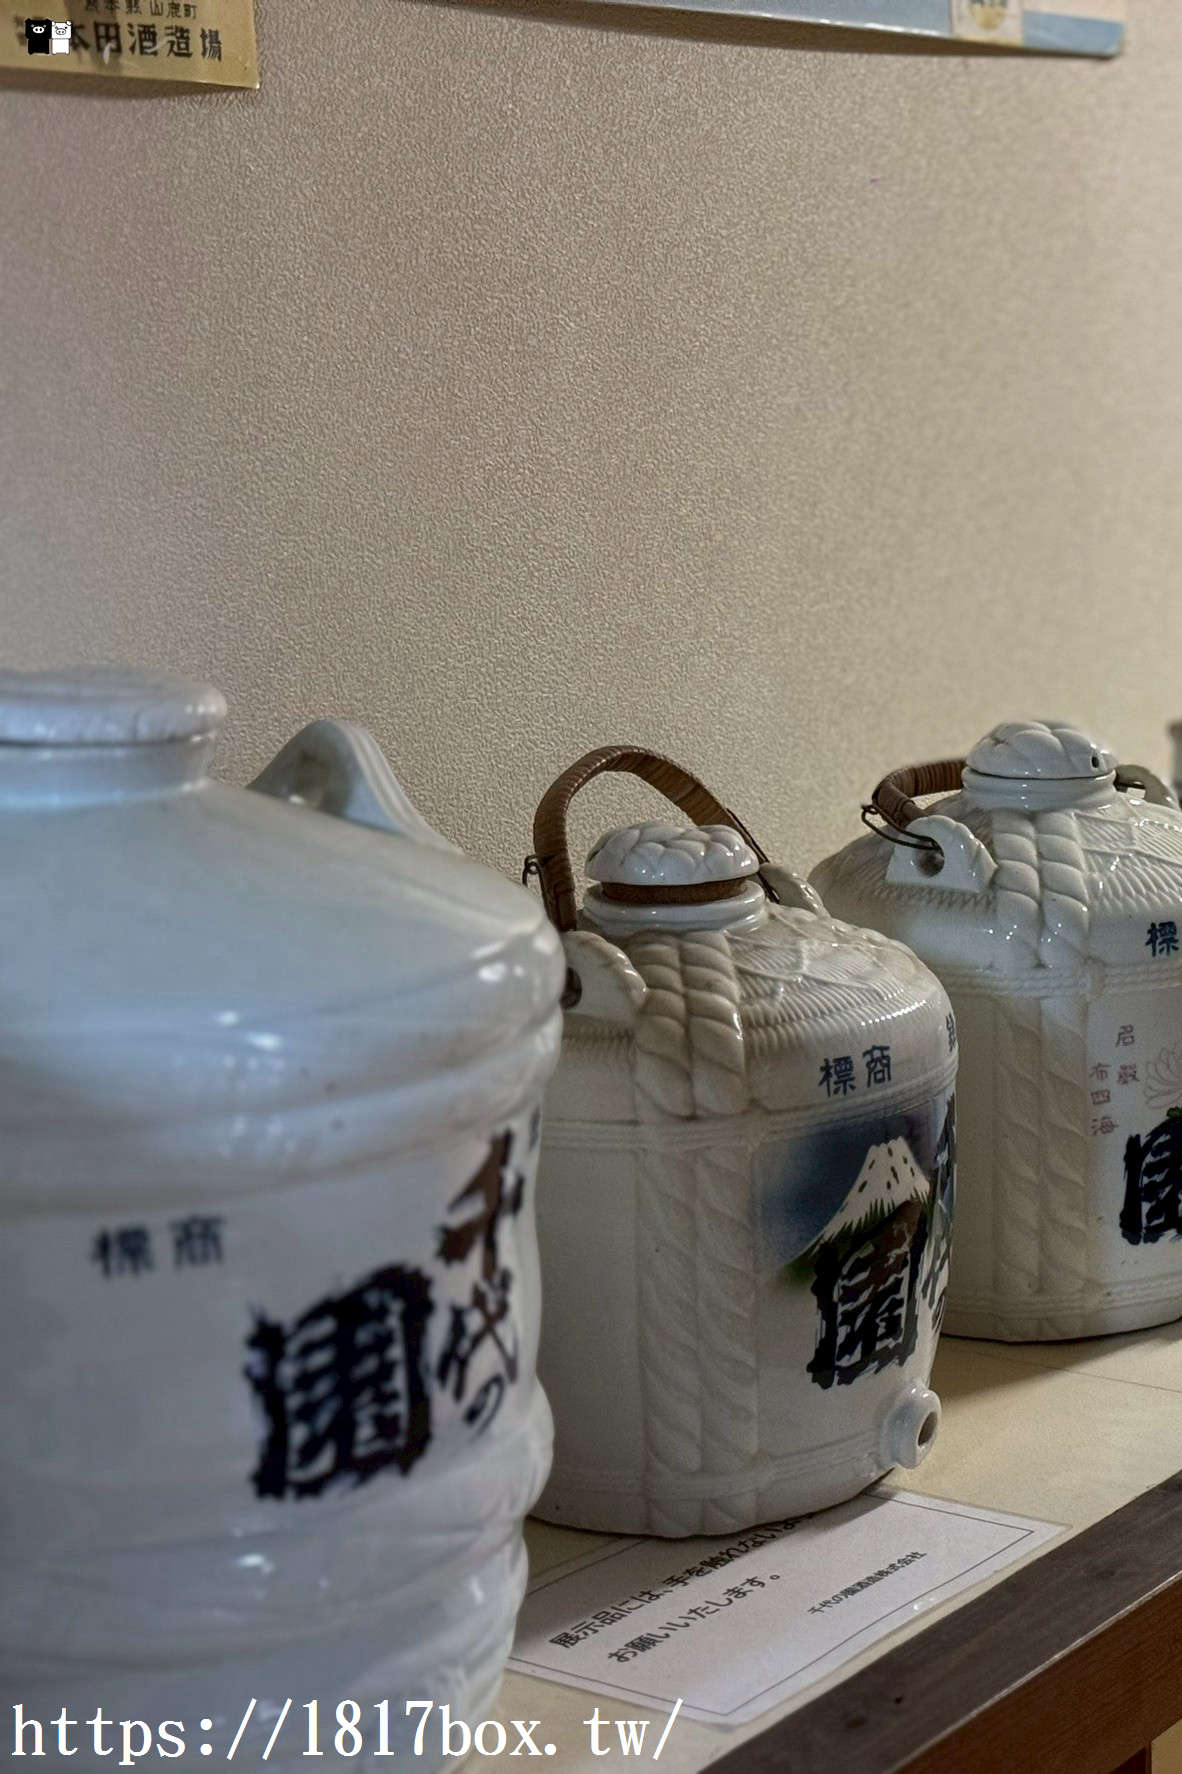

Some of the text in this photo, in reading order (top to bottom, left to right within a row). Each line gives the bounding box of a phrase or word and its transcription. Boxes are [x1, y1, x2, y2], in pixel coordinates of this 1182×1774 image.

[549, 1514, 812, 1650] 展示品には、手を触れないよ
[607, 1573, 781, 1664] お願いいたします。
